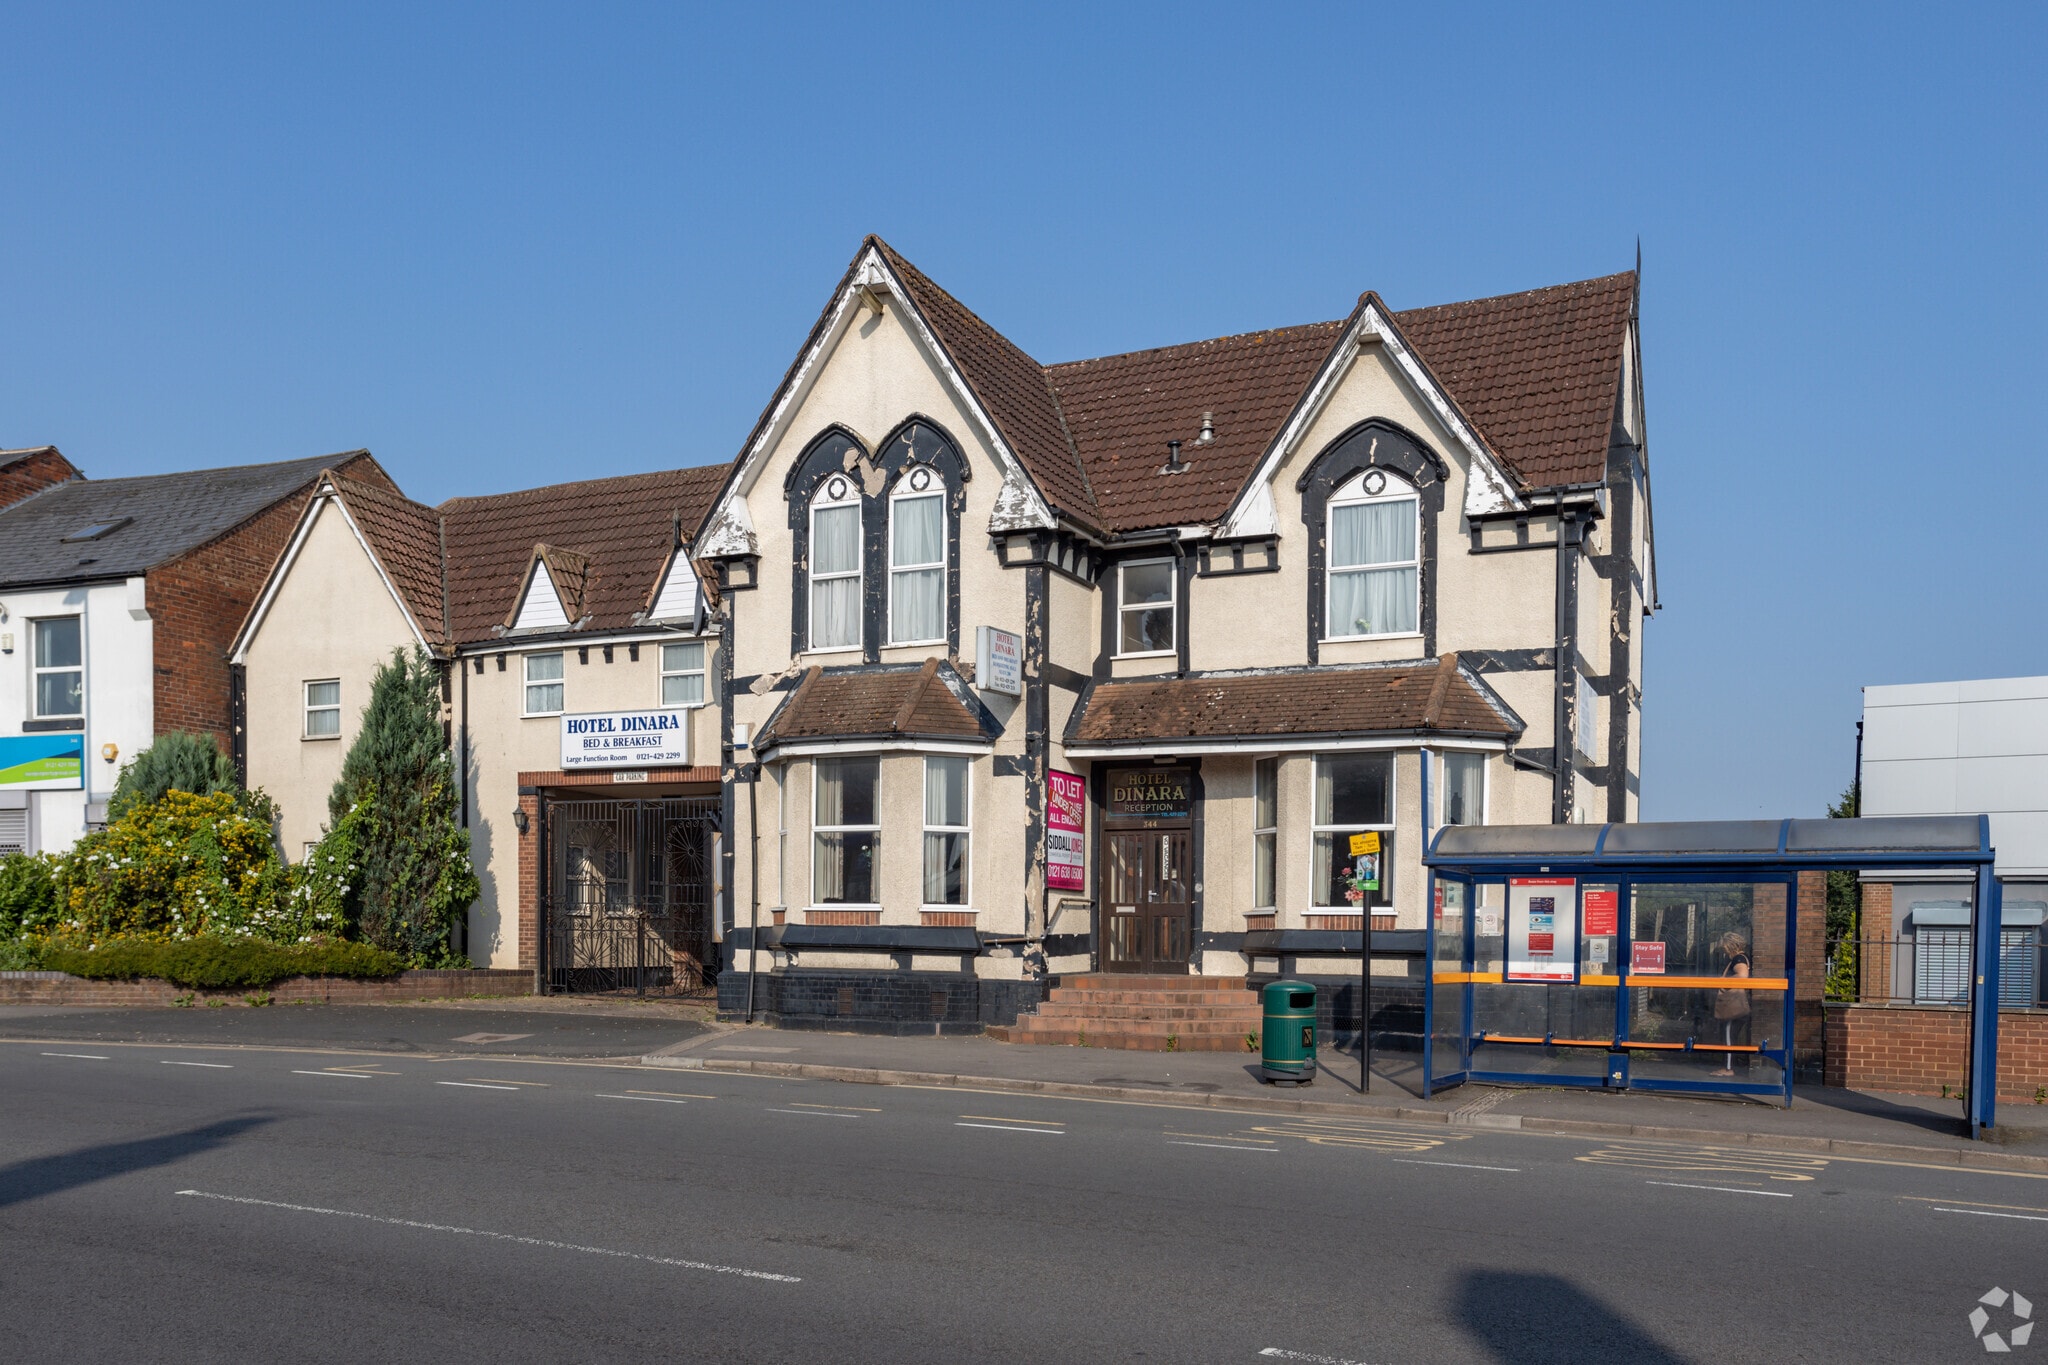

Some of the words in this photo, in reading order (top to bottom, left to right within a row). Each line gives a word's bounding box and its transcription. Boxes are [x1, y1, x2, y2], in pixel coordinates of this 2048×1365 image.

[996, 632, 1014, 645] HOTEL
[995, 643, 1015, 656] DINARA
[567, 718, 616, 734] HOTEL
[621, 715, 680, 731] DINARA
[583, 738, 600, 748] BED
[603, 738, 611, 747] &
[613, 736, 662, 747] BREAKFAST
[566, 756, 582, 764] Large
[1128, 773, 1172, 785] HOTEL
[1052, 776, 1065, 795] TO
[1066, 780, 1081, 799] LET
[1114, 786, 1186, 801] DINARA
[1052, 791, 1069, 813] UNDER
[1070, 805, 1082, 827] OFFER
[1124, 803, 1173, 812] RECEPTION
[1050, 812, 1061, 823] ALL
[1048, 835, 1071, 851] SIDDALL
[1048, 865, 1060, 877] 0121
[1061, 866, 1070, 879] 638
[1635, 944, 1648, 952] Stay
